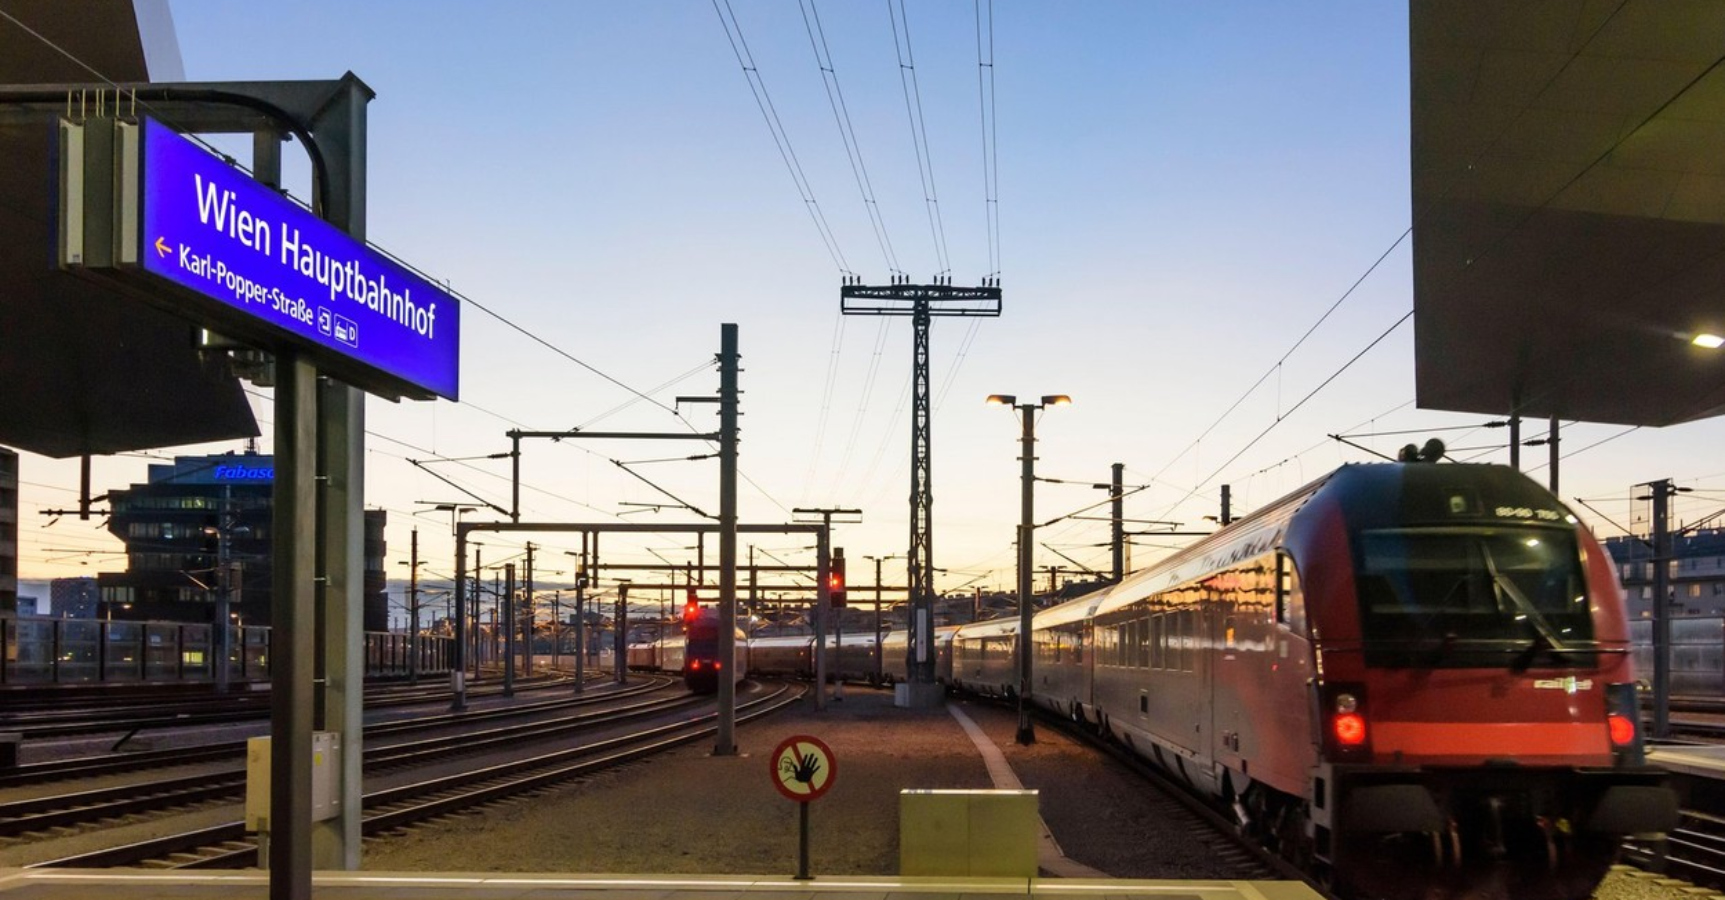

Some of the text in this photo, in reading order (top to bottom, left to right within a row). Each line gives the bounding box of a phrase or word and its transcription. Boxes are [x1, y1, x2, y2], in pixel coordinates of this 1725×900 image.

[179, 243, 314, 326] Karl-Popper-Straße
[194, 173, 436, 340] Wien Hauptbahnhof
